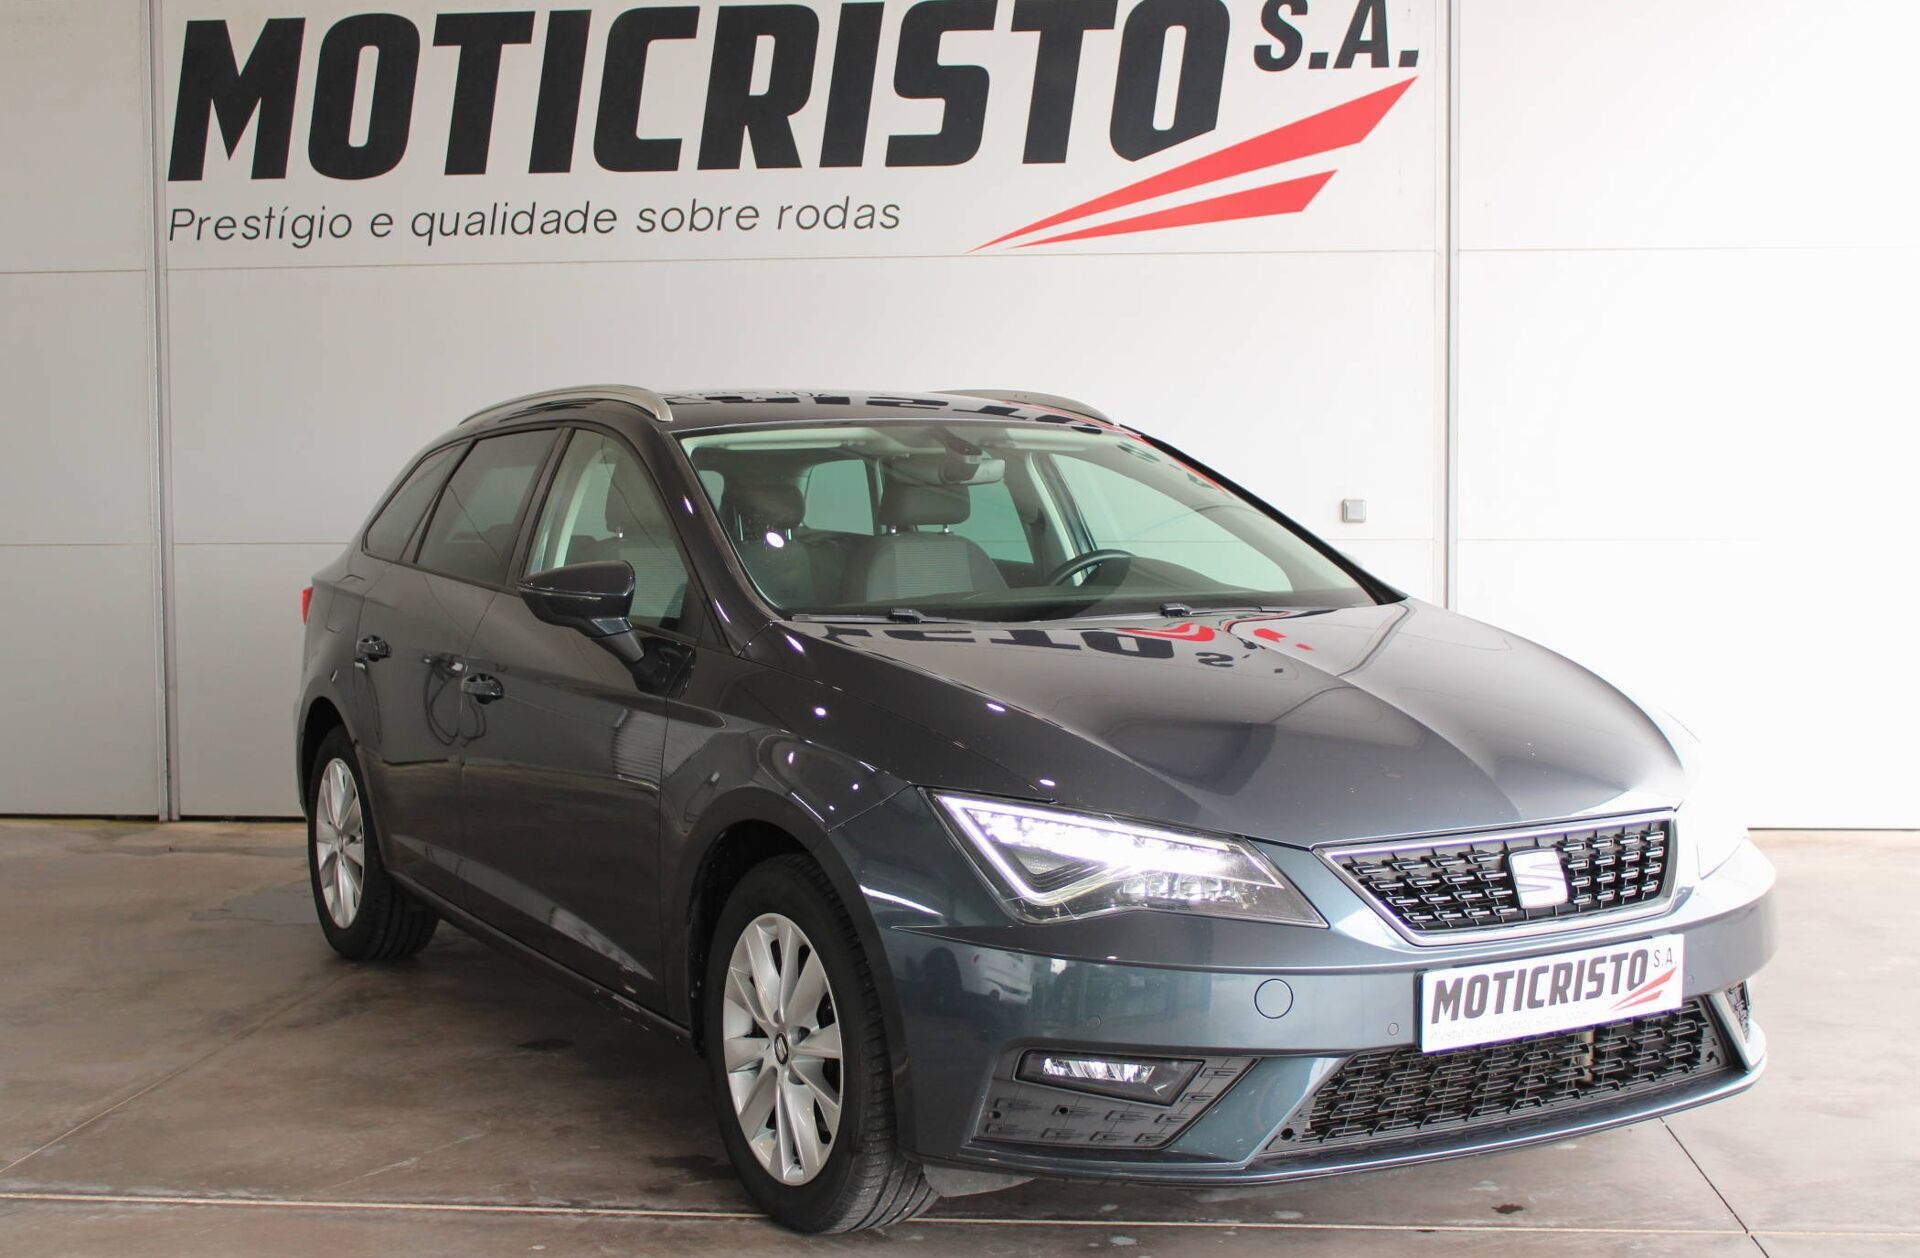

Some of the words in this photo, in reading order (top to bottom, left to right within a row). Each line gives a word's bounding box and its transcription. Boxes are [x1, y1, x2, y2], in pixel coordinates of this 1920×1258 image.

[168, 0, 1231, 181] MOTICRISTO
[1253, 0, 1419, 72] S.A.
[169, 205, 353, 249] Prestígio
[370, 212, 394, 238] e
[411, 200, 618, 247] qualidade
[636, 198, 760, 234] sobre
[777, 195, 900, 231] rodas
[1431, 948, 1649, 1025] MOTICRISTO
